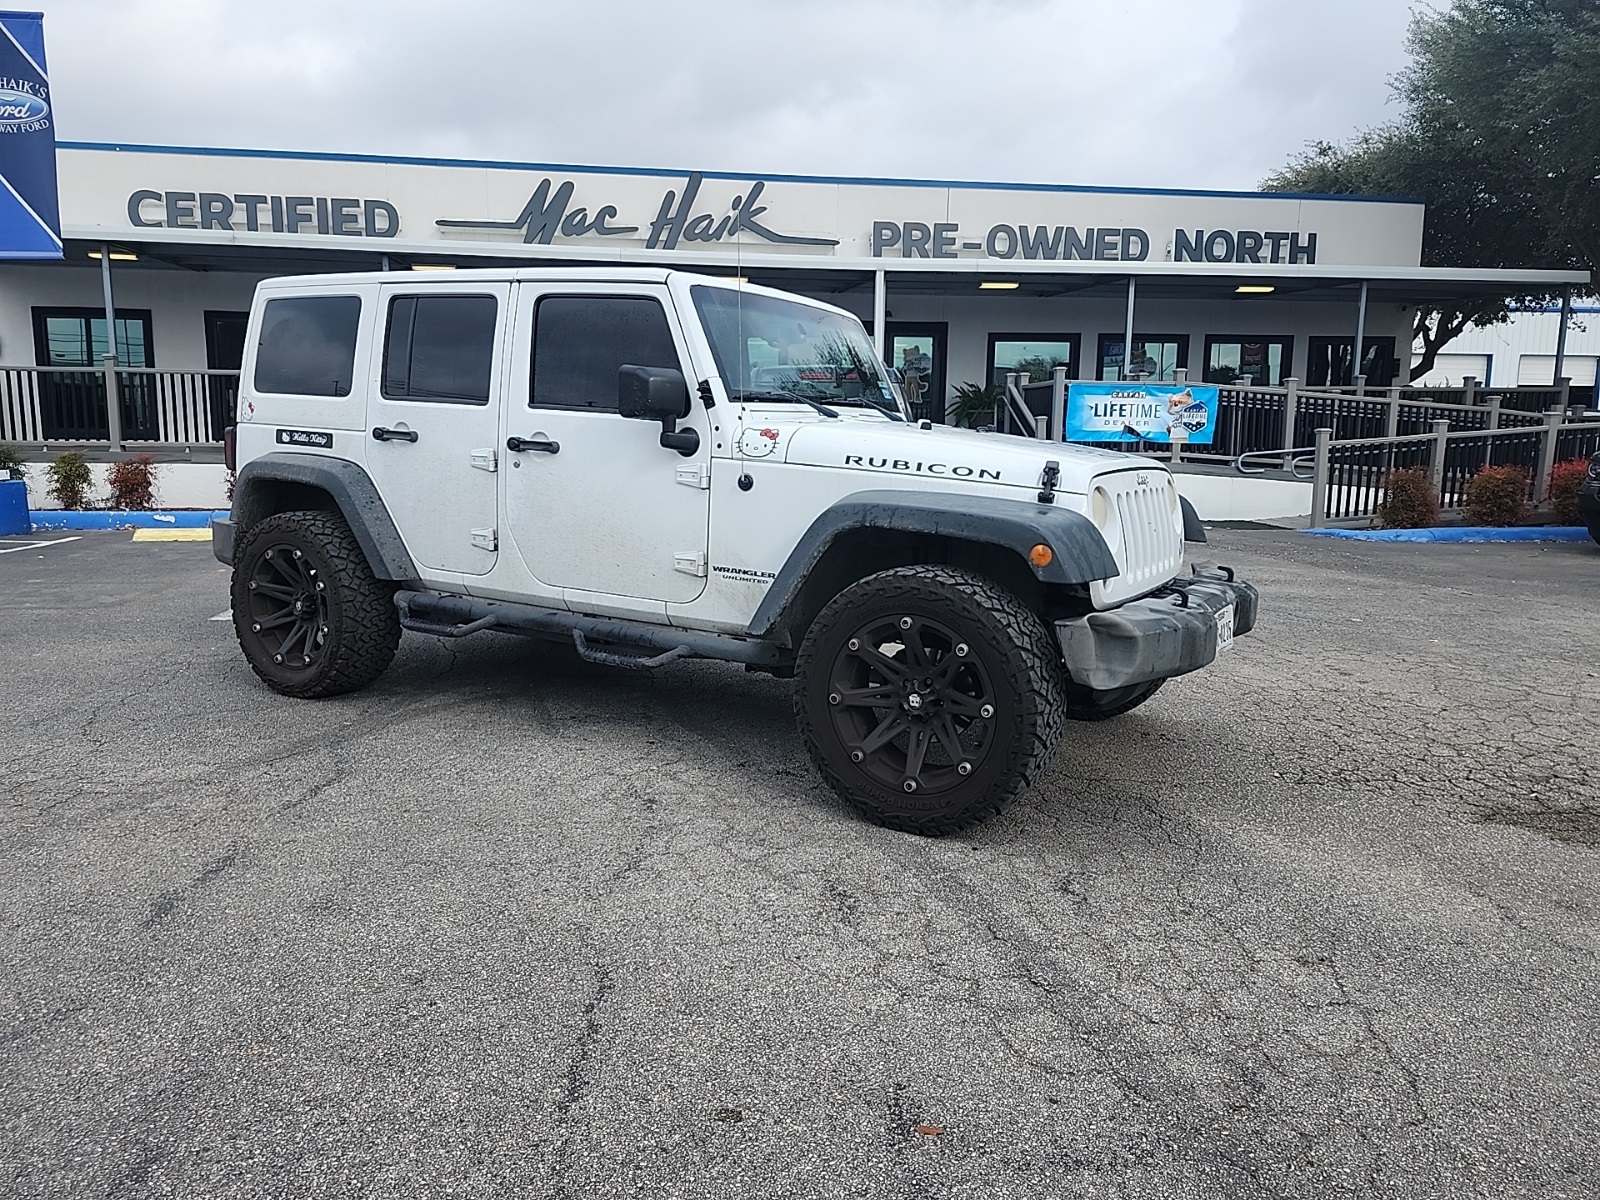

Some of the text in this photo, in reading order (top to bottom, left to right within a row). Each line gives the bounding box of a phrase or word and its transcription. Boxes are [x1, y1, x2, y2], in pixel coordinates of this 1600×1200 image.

[0, 77, 48, 98] HAIK'S
[20, 119, 49, 133] FORD
[127, 189, 400, 238] CERTIFIED
[435, 171, 840, 250] Mac Haik
[872, 221, 1317, 264] PRE-OWNED NORTH
[1094, 402, 1162, 419] LIFETIME
[1104, 419, 1150, 427] DEALER
[292, 431, 328, 446] Hello Kitty
[845, 454, 1001, 480] RUBICON
[712, 565, 776, 579] WRANGLER
[722, 574, 769, 585] UNLIMITED
[858, 780, 939, 811] VENOM POWER
